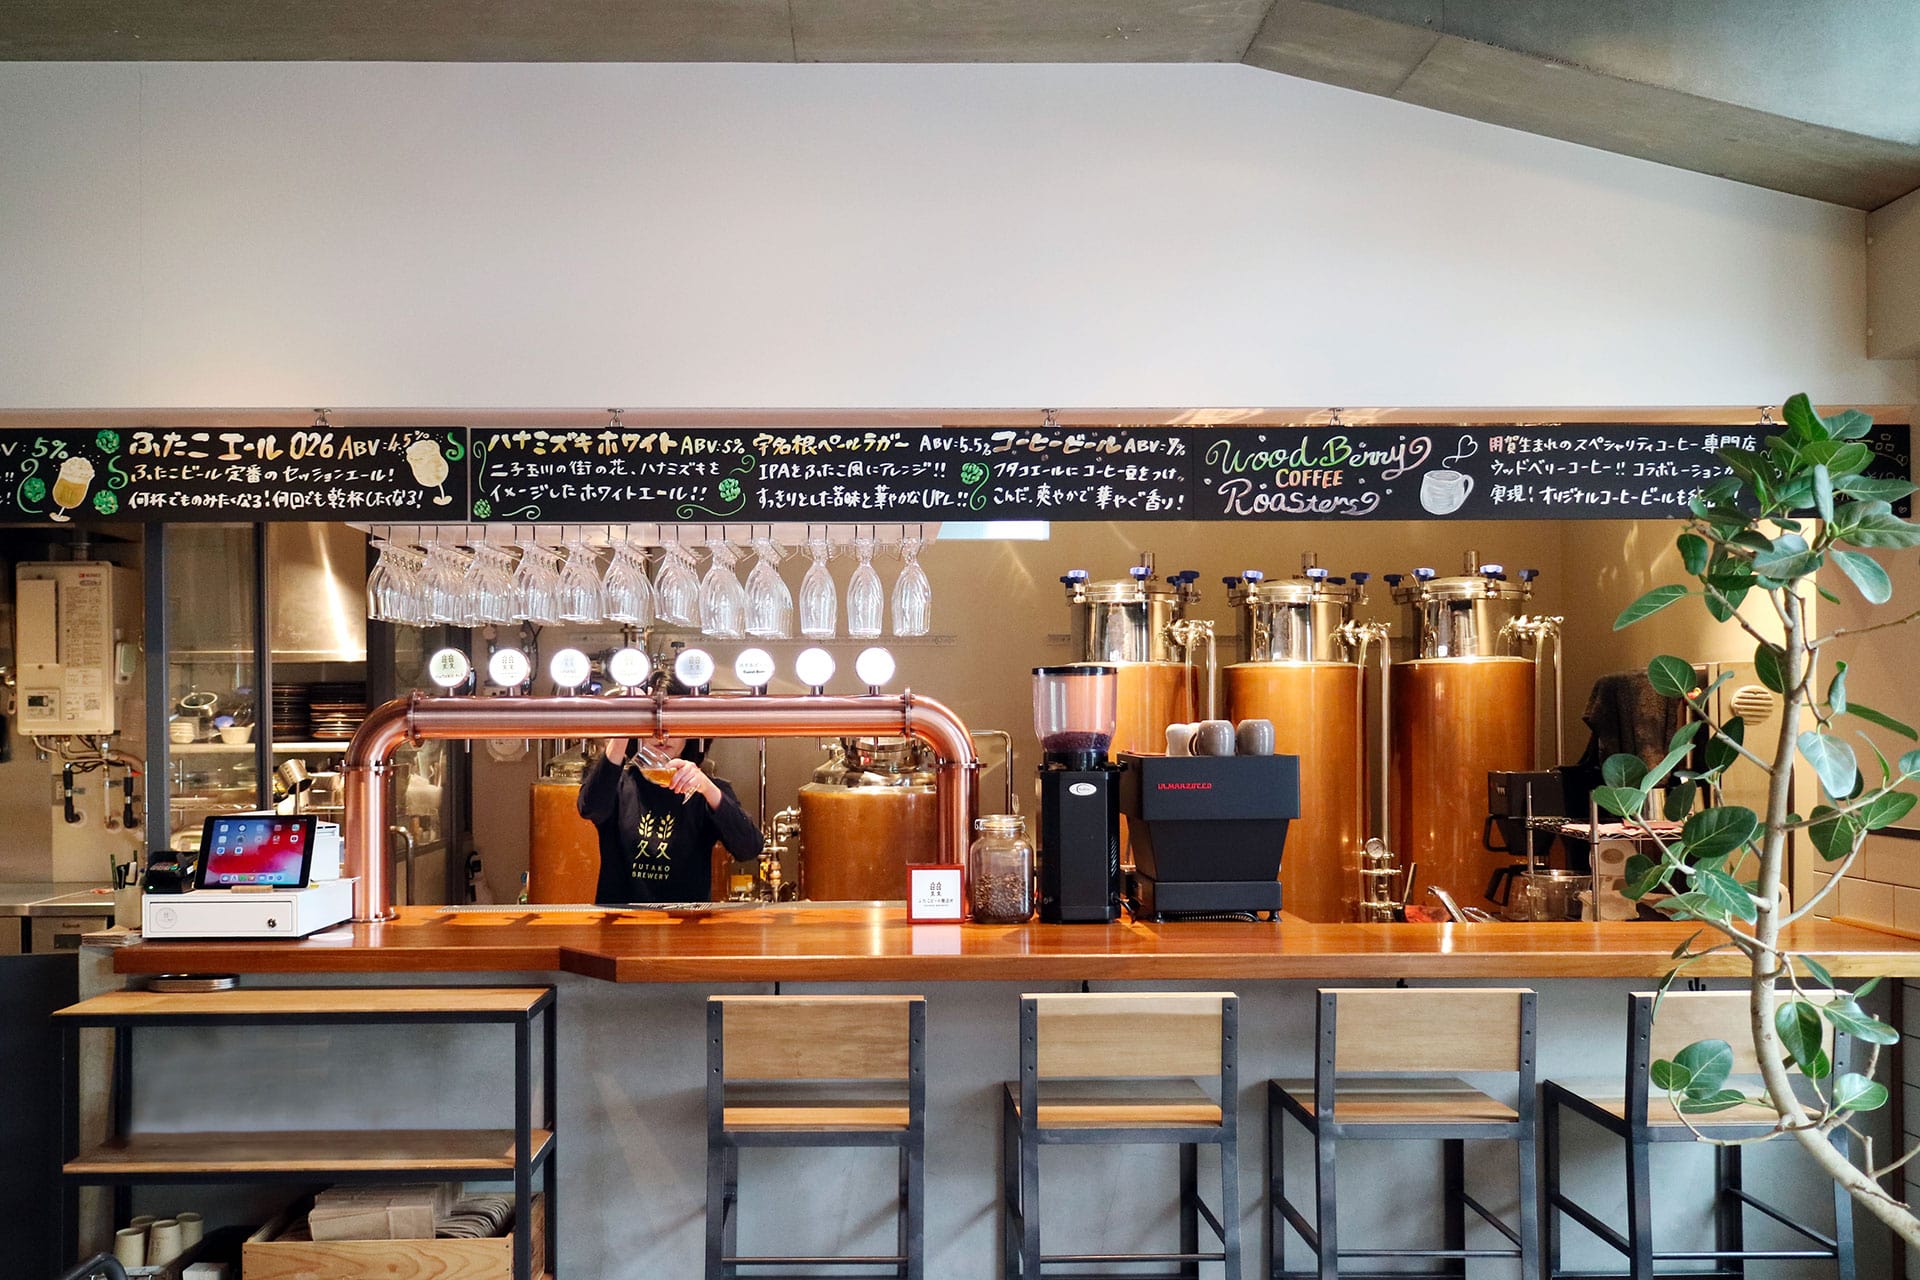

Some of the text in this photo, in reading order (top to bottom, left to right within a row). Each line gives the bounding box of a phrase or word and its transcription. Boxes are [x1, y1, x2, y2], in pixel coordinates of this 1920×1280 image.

[290, 432, 334, 460] 026
[990, 431, 1123, 455] コーヒービール
[1275, 468, 1343, 488] COFFEE
[632, 862, 671, 872] FUTAKO
[632, 871, 670, 880] BREWERY
